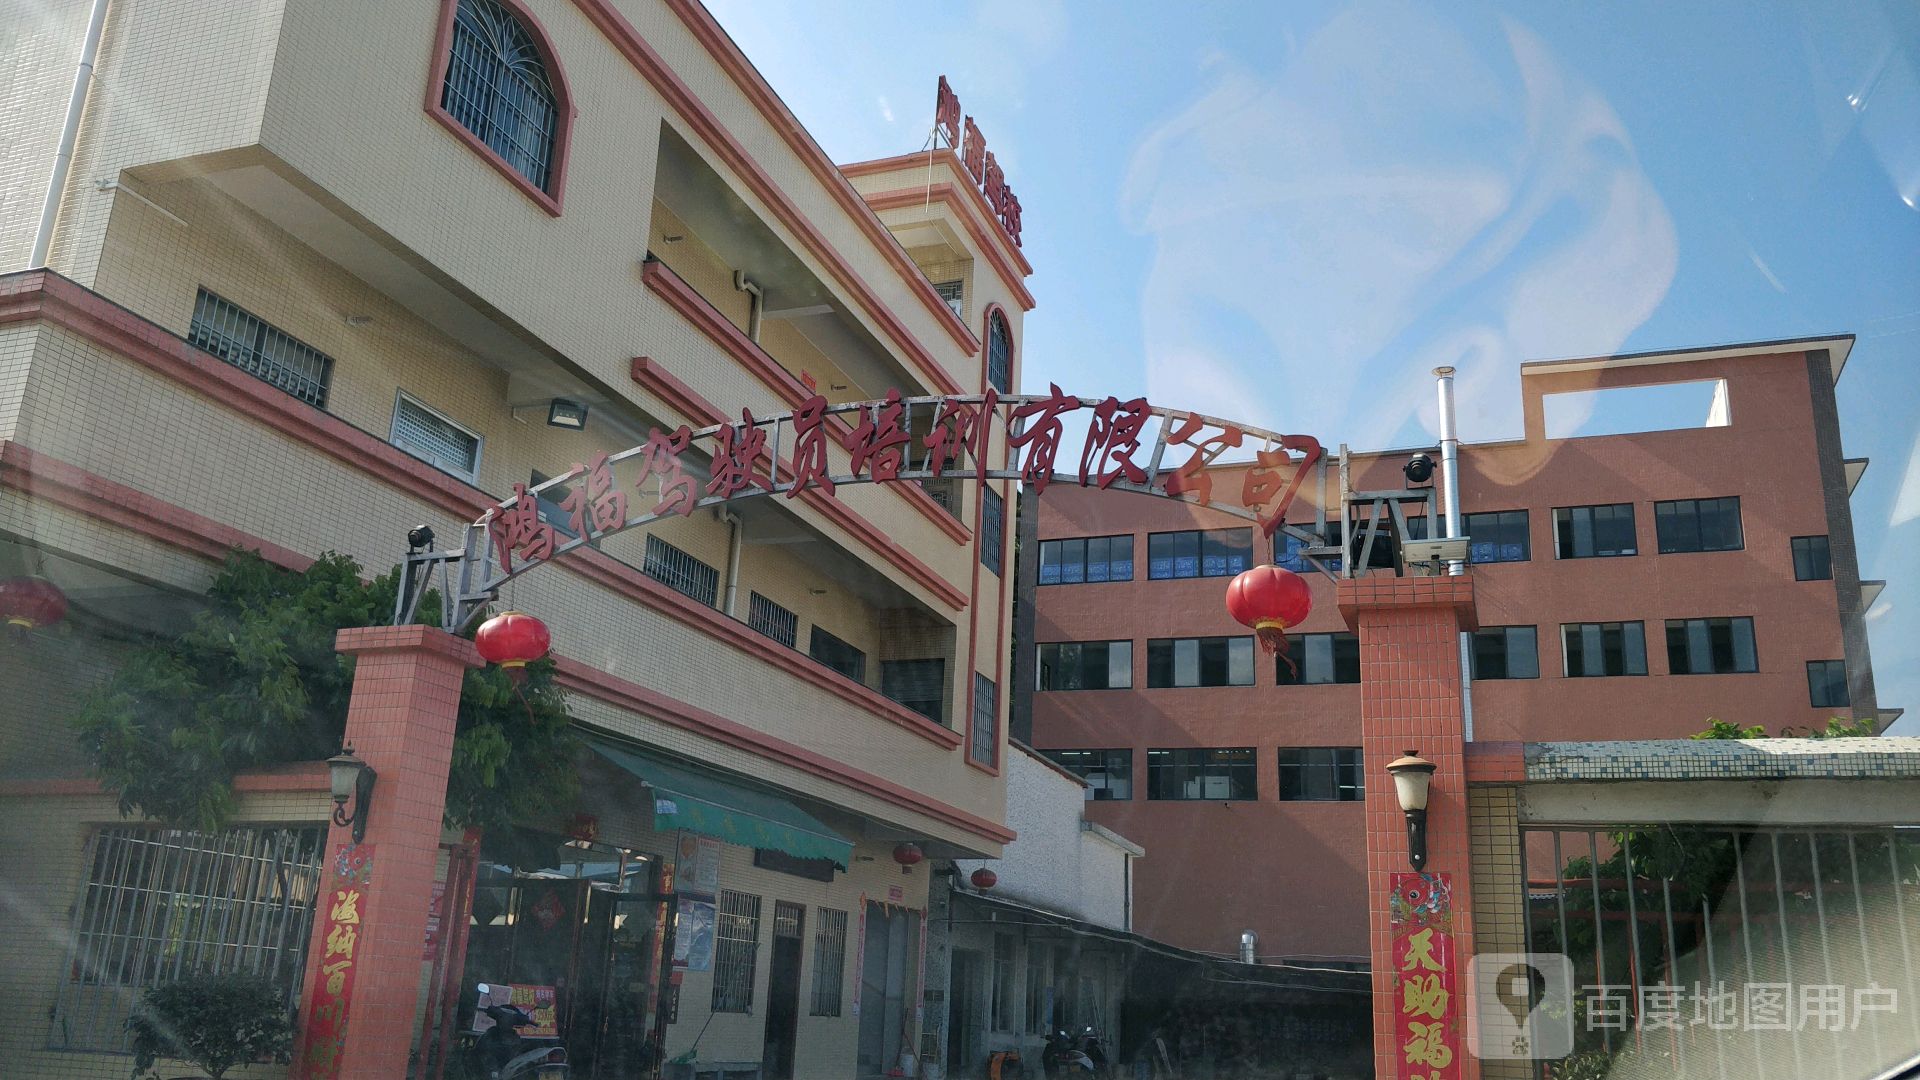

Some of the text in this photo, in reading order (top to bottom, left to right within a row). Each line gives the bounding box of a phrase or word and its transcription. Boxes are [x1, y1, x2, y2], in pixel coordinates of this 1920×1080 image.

[489, 381, 1321, 575] 鸿福驾驶员培训有限公司
[1402, 927, 1453, 1080] 天助福
